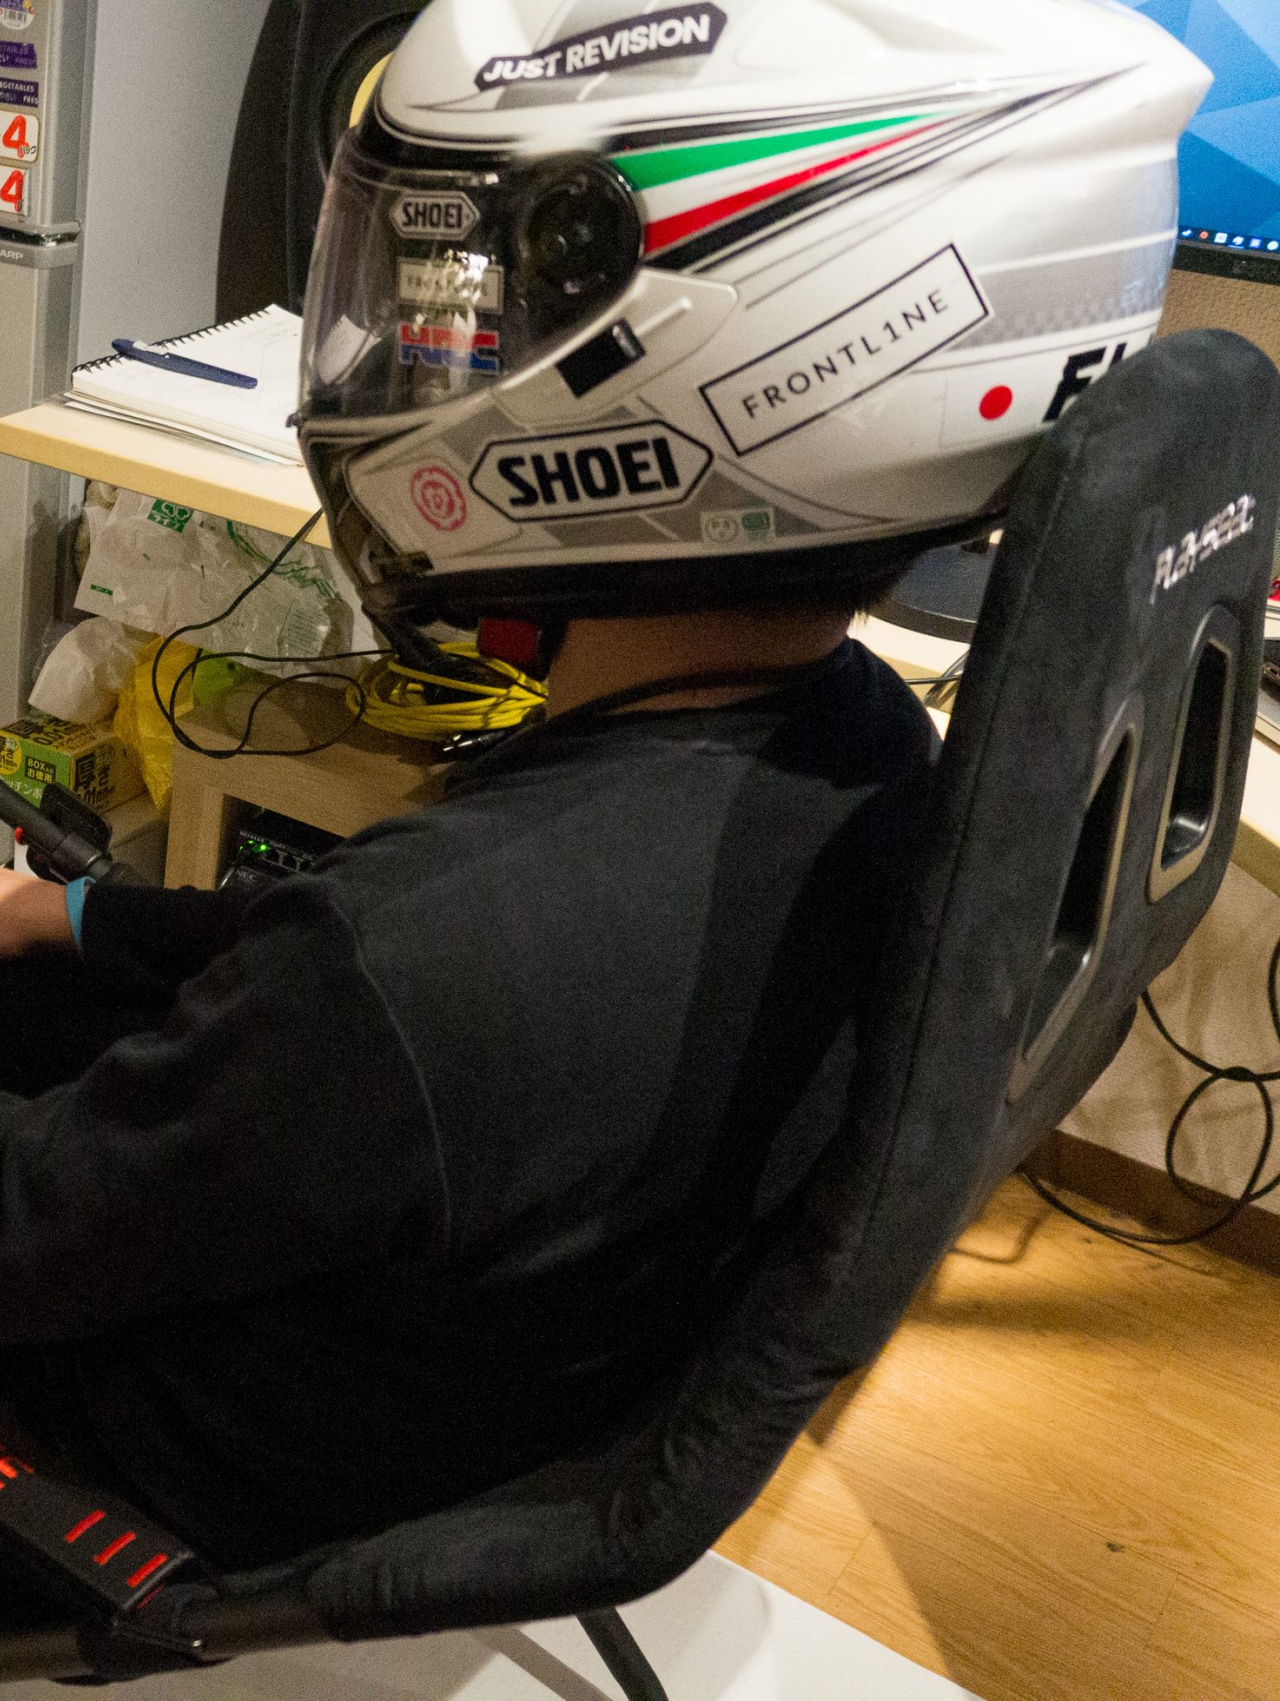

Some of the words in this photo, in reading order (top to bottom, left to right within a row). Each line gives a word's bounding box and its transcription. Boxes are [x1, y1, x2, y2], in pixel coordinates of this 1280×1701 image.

[482, 53, 561, 83] JUST
[565, 13, 711, 73] REVISION
[401, 200, 463, 229] SHOEI
[497, 437, 681, 508] SHOEI
